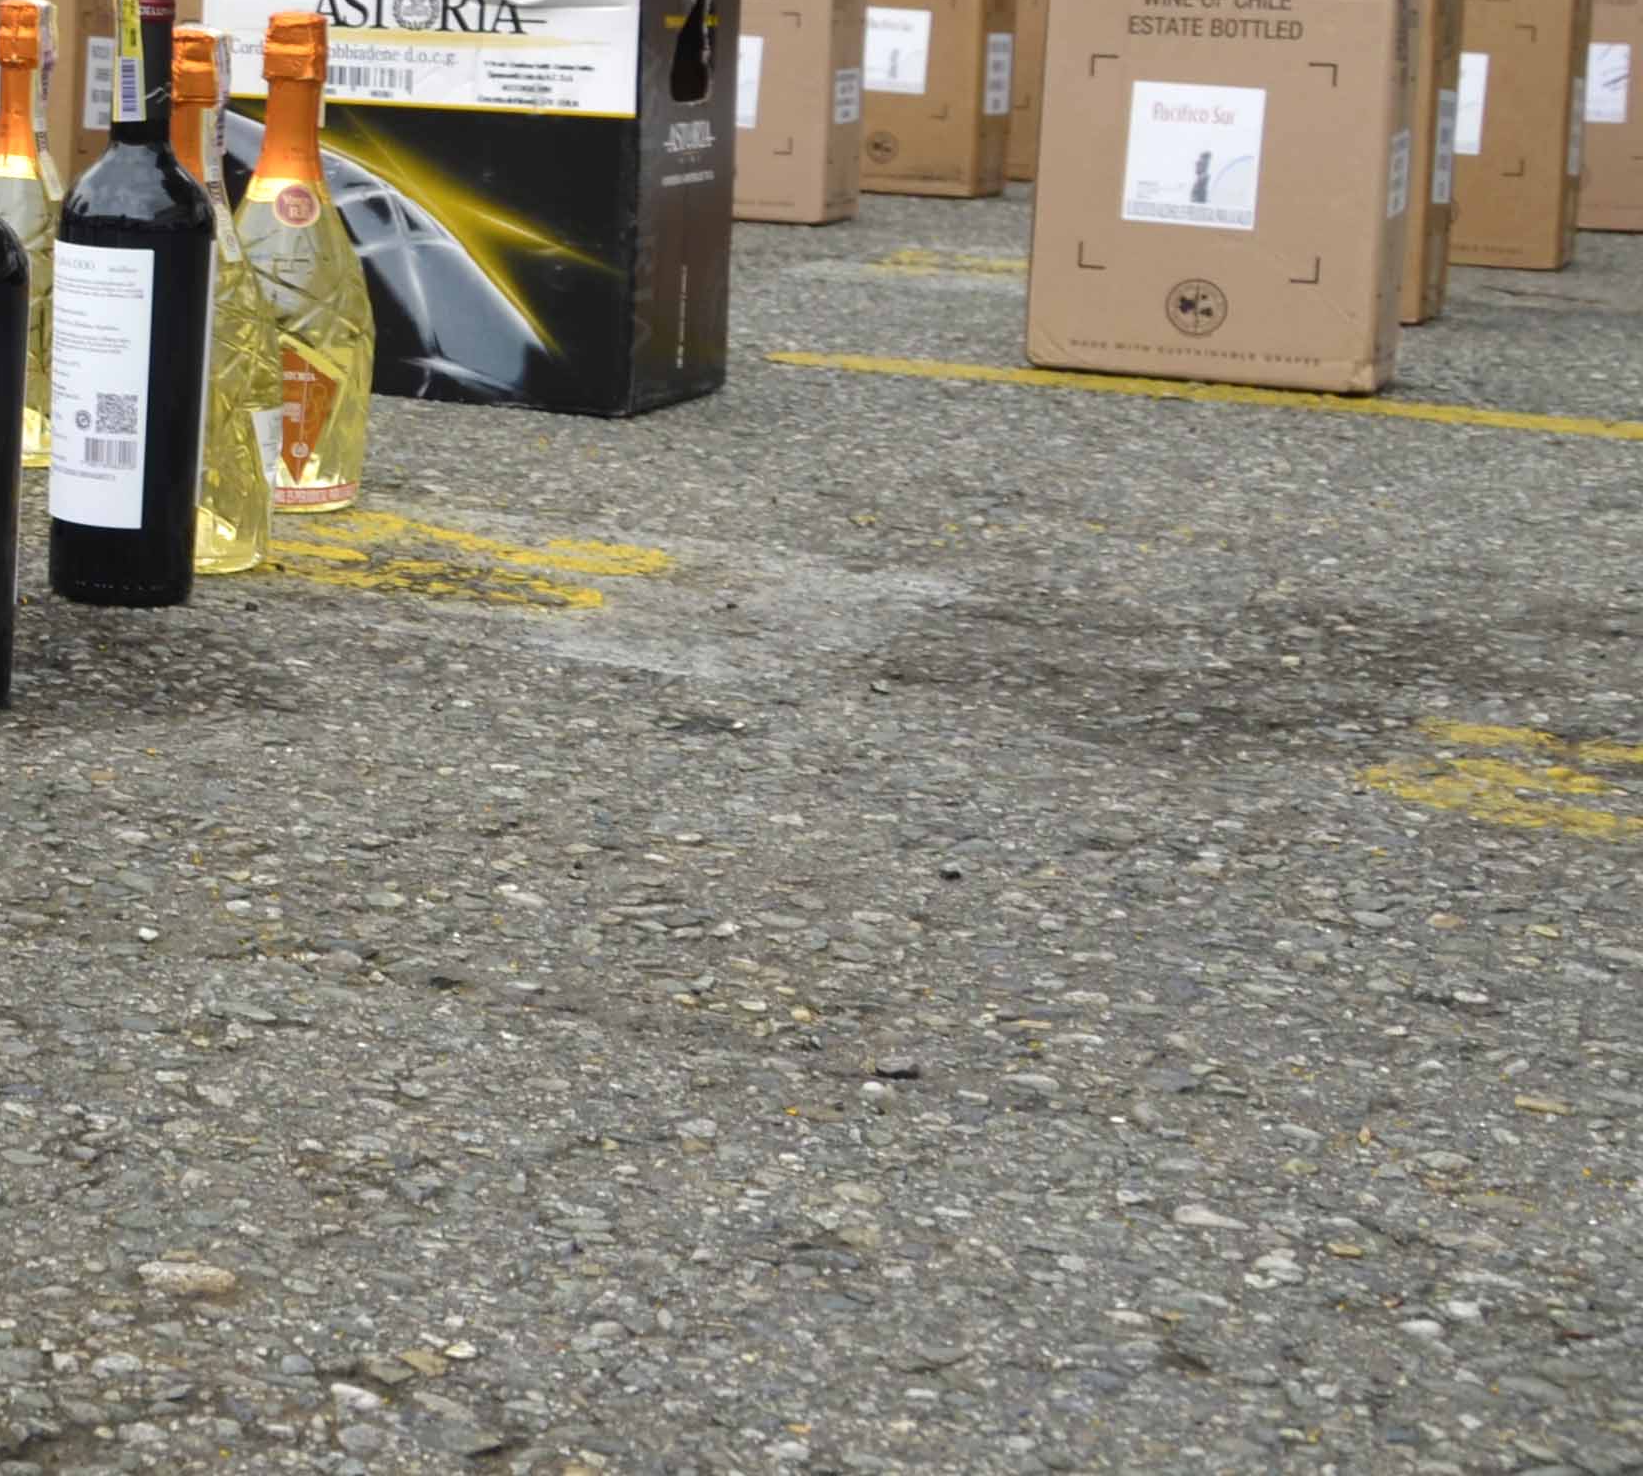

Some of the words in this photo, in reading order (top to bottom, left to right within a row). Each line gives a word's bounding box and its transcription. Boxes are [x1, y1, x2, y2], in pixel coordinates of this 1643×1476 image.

[1128, 16, 1203, 37] ESTATE
[1210, 18, 1304, 41] BOTTLED
[1151, 100, 1208, 123] Pacifico
[1213, 107, 1235, 125] Sur
